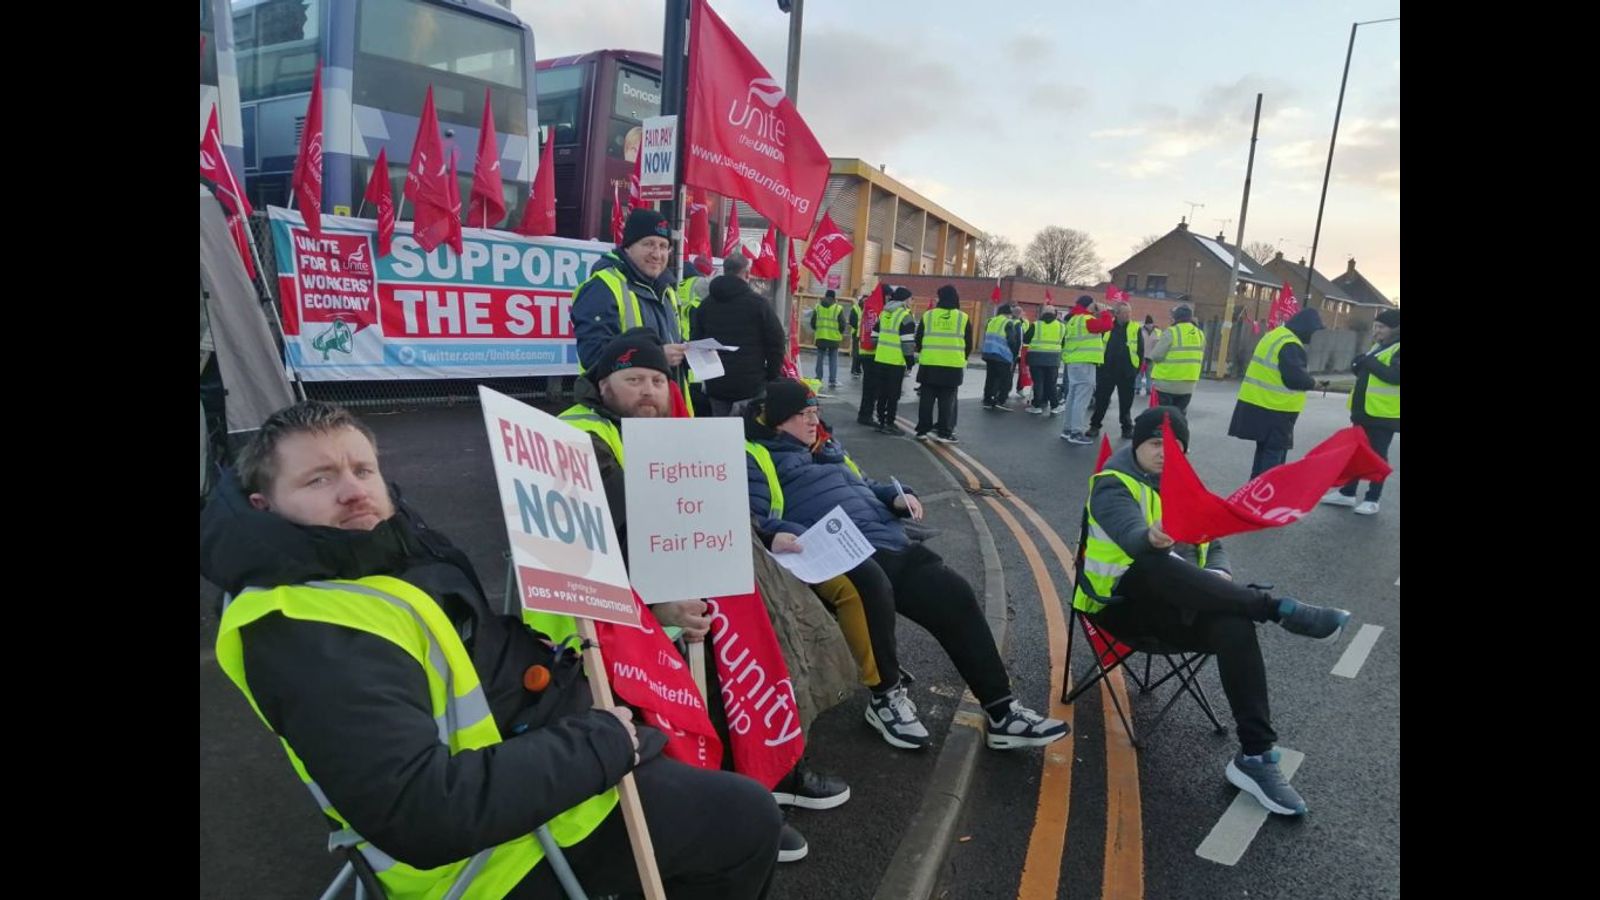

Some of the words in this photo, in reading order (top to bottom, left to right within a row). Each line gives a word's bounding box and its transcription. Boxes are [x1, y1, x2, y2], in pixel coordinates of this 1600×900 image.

[645, 128, 659, 148] FAIR
[660, 126, 672, 147] PAY
[644, 151, 672, 174] NOW
[296, 235, 341, 254] UNITE
[300, 254, 327, 272] FOR
[330, 258, 341, 272] A
[390, 235, 601, 287] SUPPORT
[302, 274, 372, 293] WORKERS'
[304, 293, 370, 311] ECONOMY
[393, 289, 494, 335] THE
[421, 349, 556, 363] Twitter.com/UniteEconomy
[497, 416, 556, 478] FAIR
[553, 438, 593, 491] PAY
[649, 462, 728, 484] Fighting
[513, 477, 608, 555] NOW
[677, 497, 704, 515] for
[650, 534, 688, 552] Fair
[693, 530, 734, 552] Pay!
[527, 585, 552, 599] JOBS
[560, 590, 578, 603] PAY
[585, 595, 634, 614] CONDITIONS
[718, 673, 751, 735] hip
